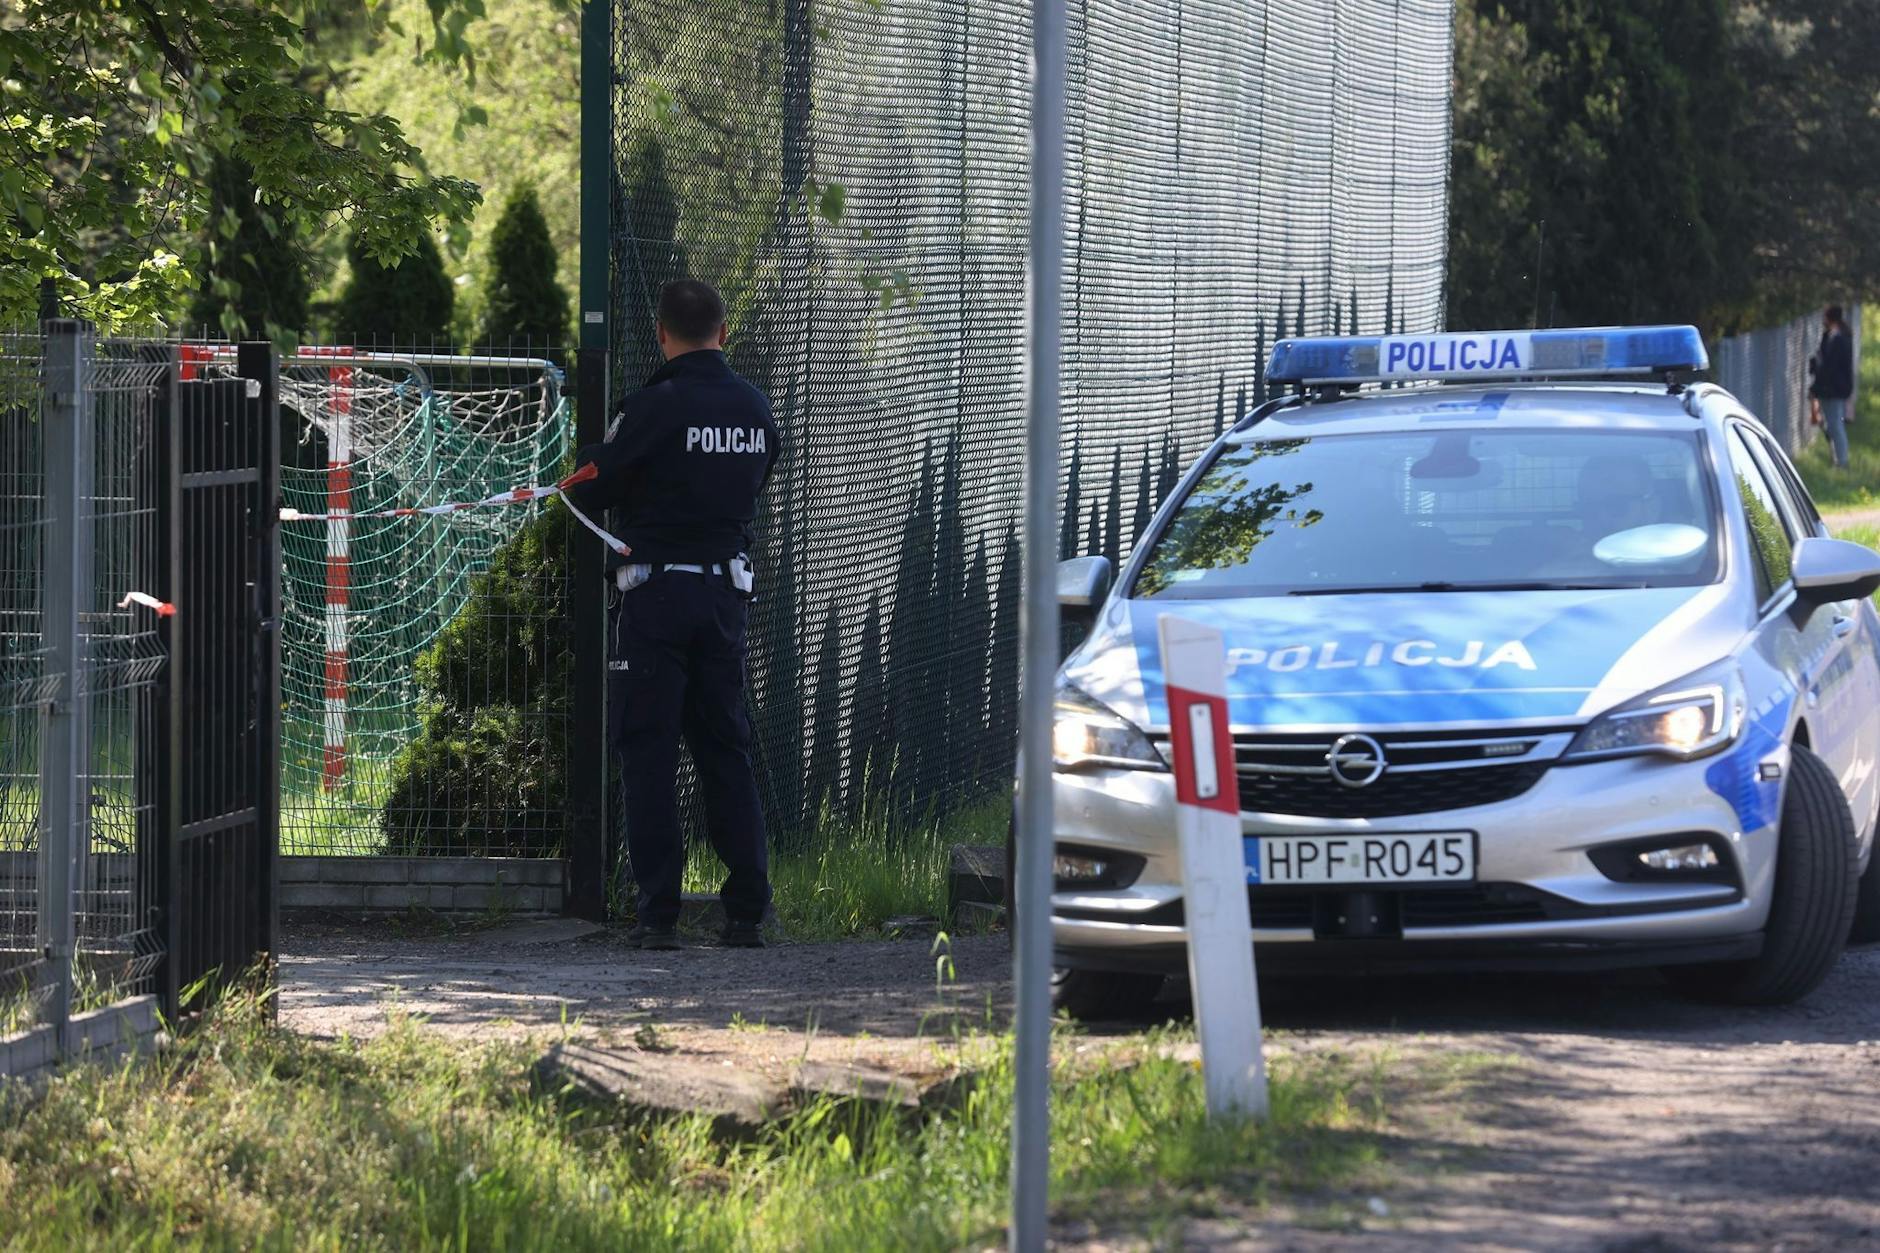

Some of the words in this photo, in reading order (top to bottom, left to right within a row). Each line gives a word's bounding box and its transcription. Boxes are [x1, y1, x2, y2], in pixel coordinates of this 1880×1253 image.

[1387, 338, 1521, 372] POLICJA
[686, 426, 766, 454] POLICJA
[1223, 639, 1538, 677] POLICJA
[1267, 840, 1349, 880] HPF
[1363, 838, 1465, 879] R045
